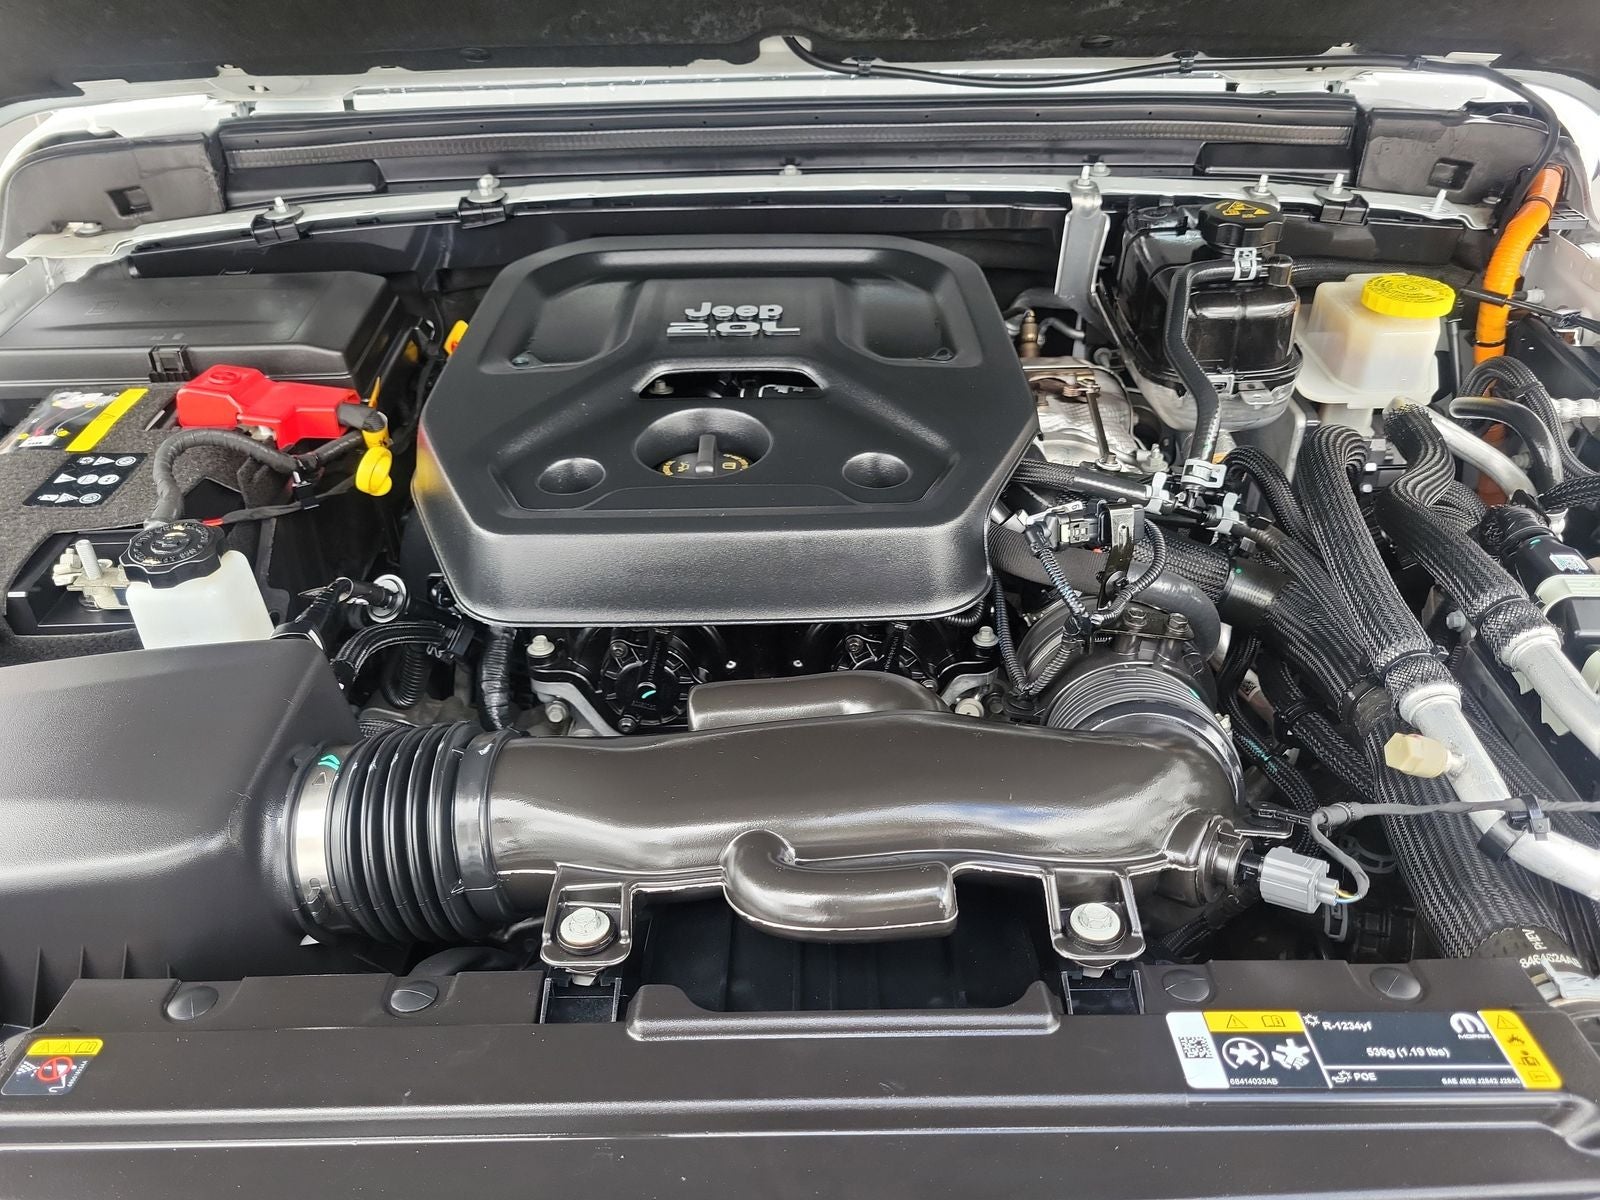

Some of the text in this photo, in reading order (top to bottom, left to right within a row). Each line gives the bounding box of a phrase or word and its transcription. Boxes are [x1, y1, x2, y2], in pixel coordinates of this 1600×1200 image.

[684, 302, 784, 320] Jeep
[666, 321, 801, 337] 2.0L
[1321, 1021, 1373, 1032] R-1234yf
[1396, 1047, 1426, 1058] (1.19
[1425, 1047, 1451, 1058] lbs)
[1229, 1078, 1279, 1086] 68414033AB
[1353, 1072, 1377, 1081] POE
[1441, 1077, 1458, 1085] SAE
